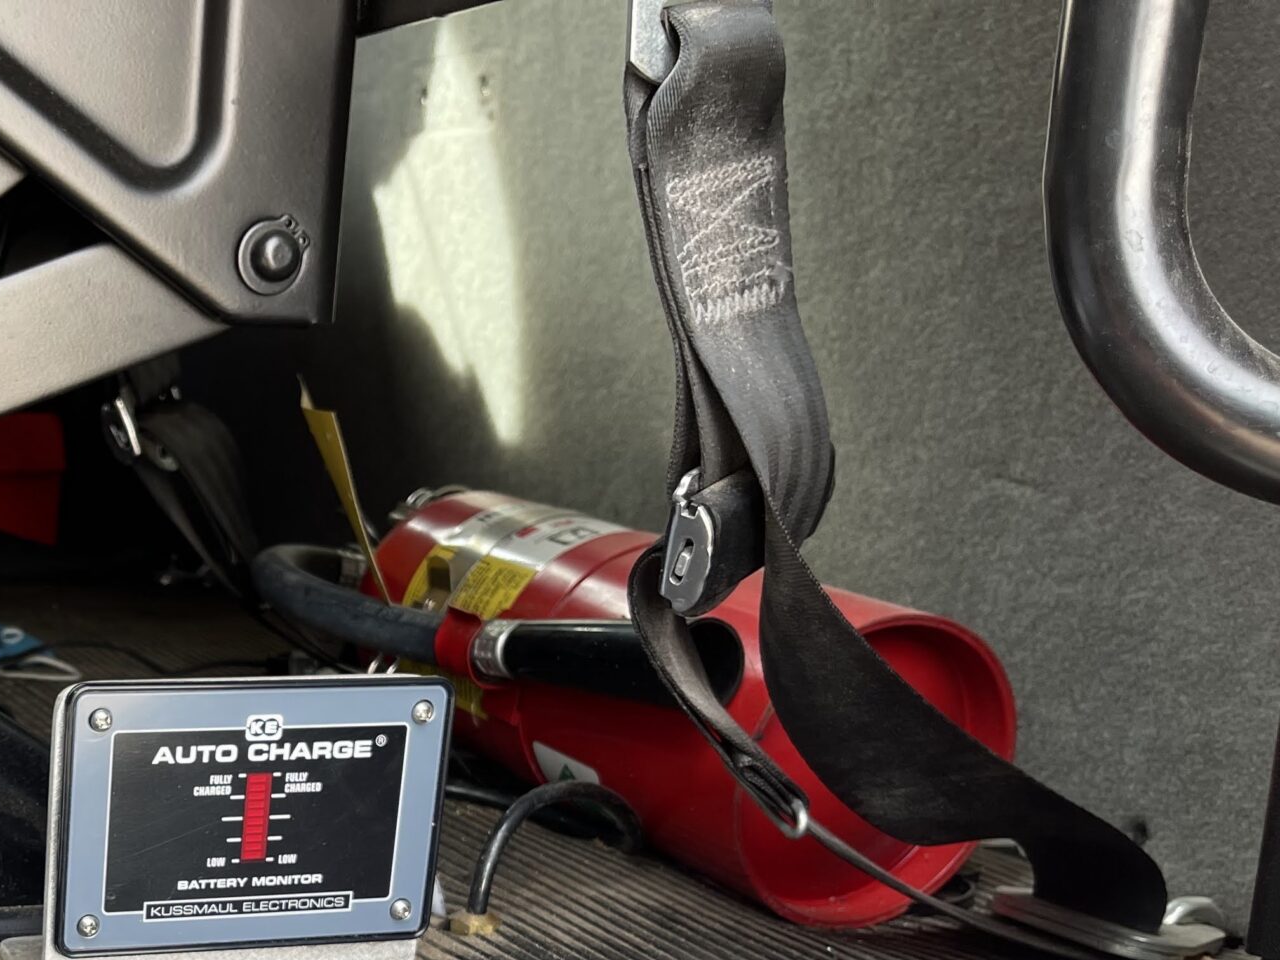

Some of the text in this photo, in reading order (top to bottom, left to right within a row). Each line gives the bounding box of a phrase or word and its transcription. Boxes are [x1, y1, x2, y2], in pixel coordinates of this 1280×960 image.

[250, 720, 279, 735] KE
[151, 744, 238, 764] AUTO
[247, 740, 373, 762] CHARGE
[209, 774, 233, 785] FULLY
[285, 772, 309, 783] FULLY
[193, 785, 232, 796] CHARGED
[284, 782, 323, 793] CHARGED
[206, 857, 226, 867] LOW
[278, 854, 297, 864] LOW
[177, 873, 323, 891] BATTERY MONITOR
[150, 896, 345, 917] KUSSMAUL ELECTRONICS
